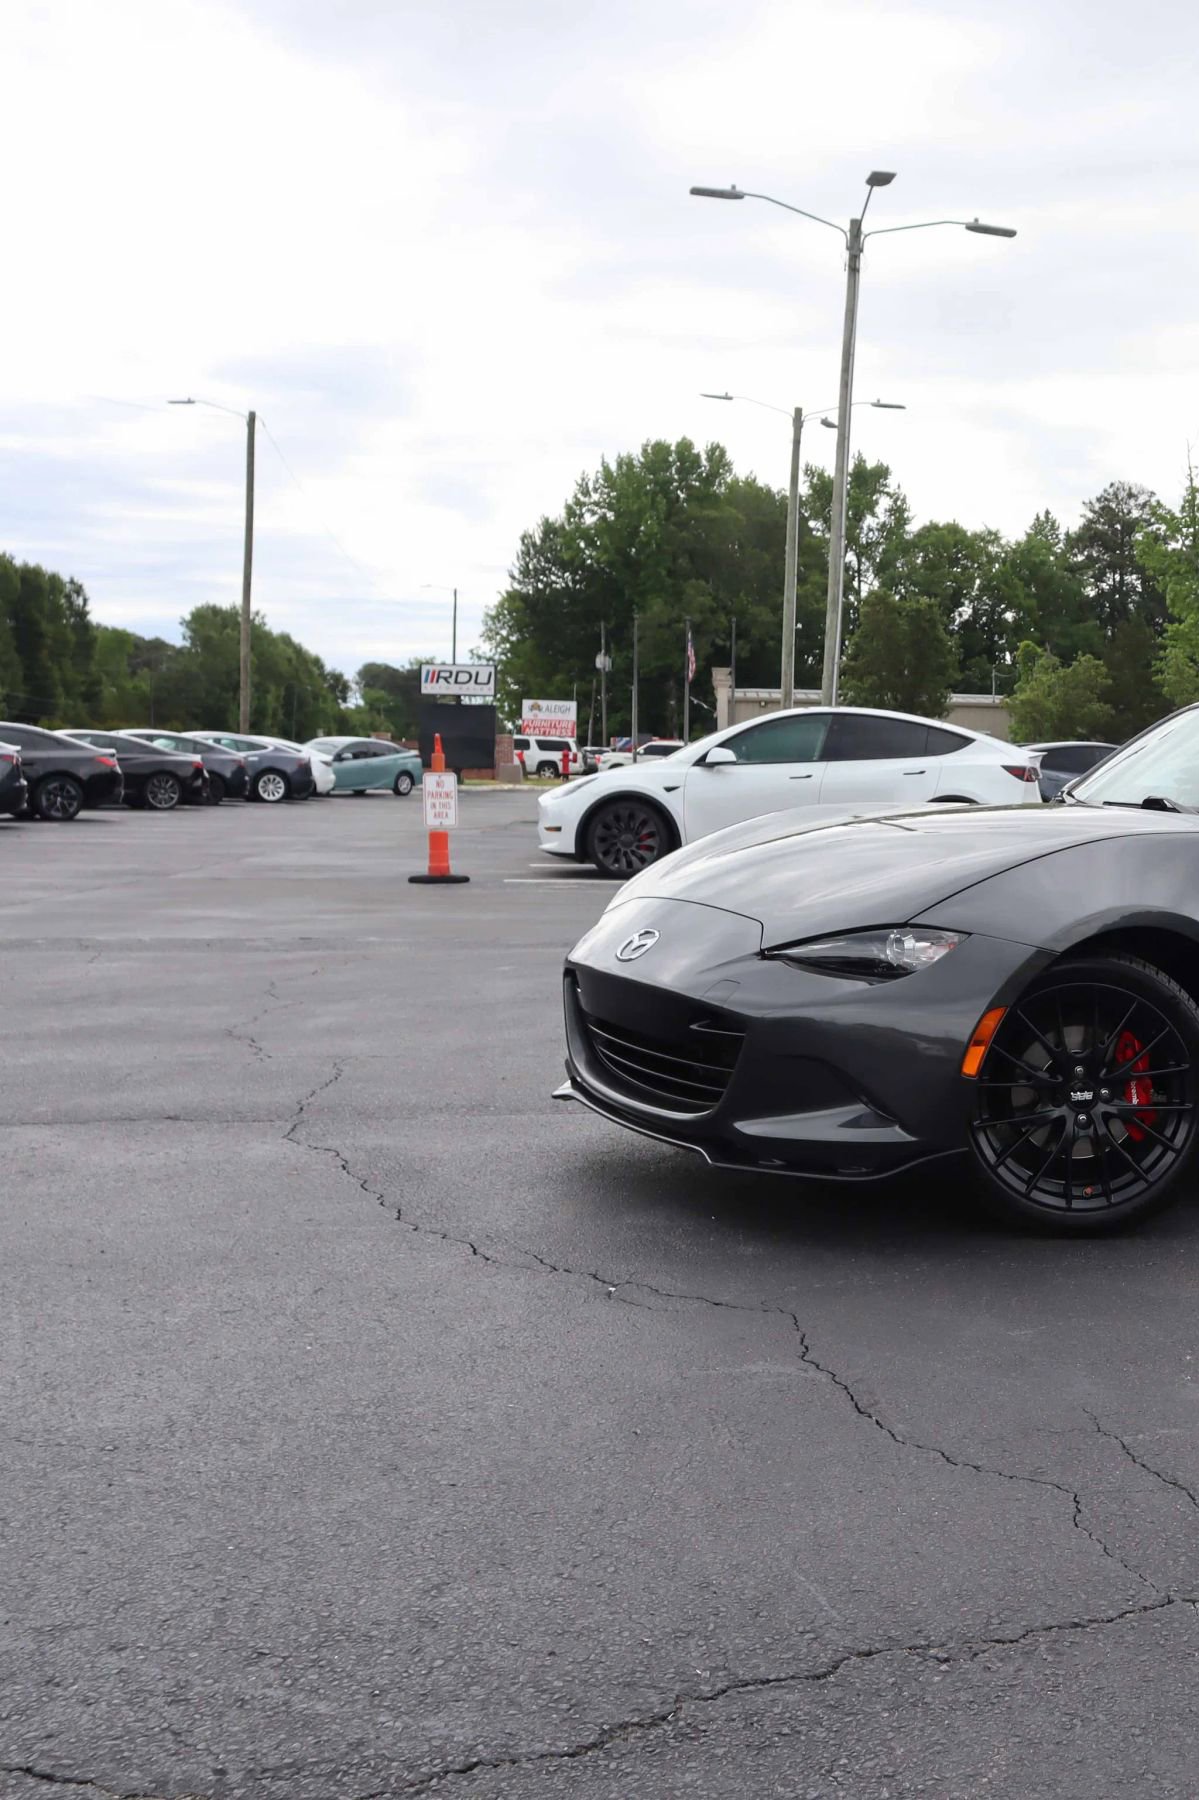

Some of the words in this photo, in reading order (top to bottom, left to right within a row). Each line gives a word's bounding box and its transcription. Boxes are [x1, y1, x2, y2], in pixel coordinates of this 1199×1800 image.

[435, 669, 492, 685] RDU
[523, 720, 573, 729] FURNITURE
[525, 728, 573, 737] MATTRESS
[435, 780, 445, 788] NO
[427, 791, 454, 800] PARKING
[433, 811, 448, 819] AREA
